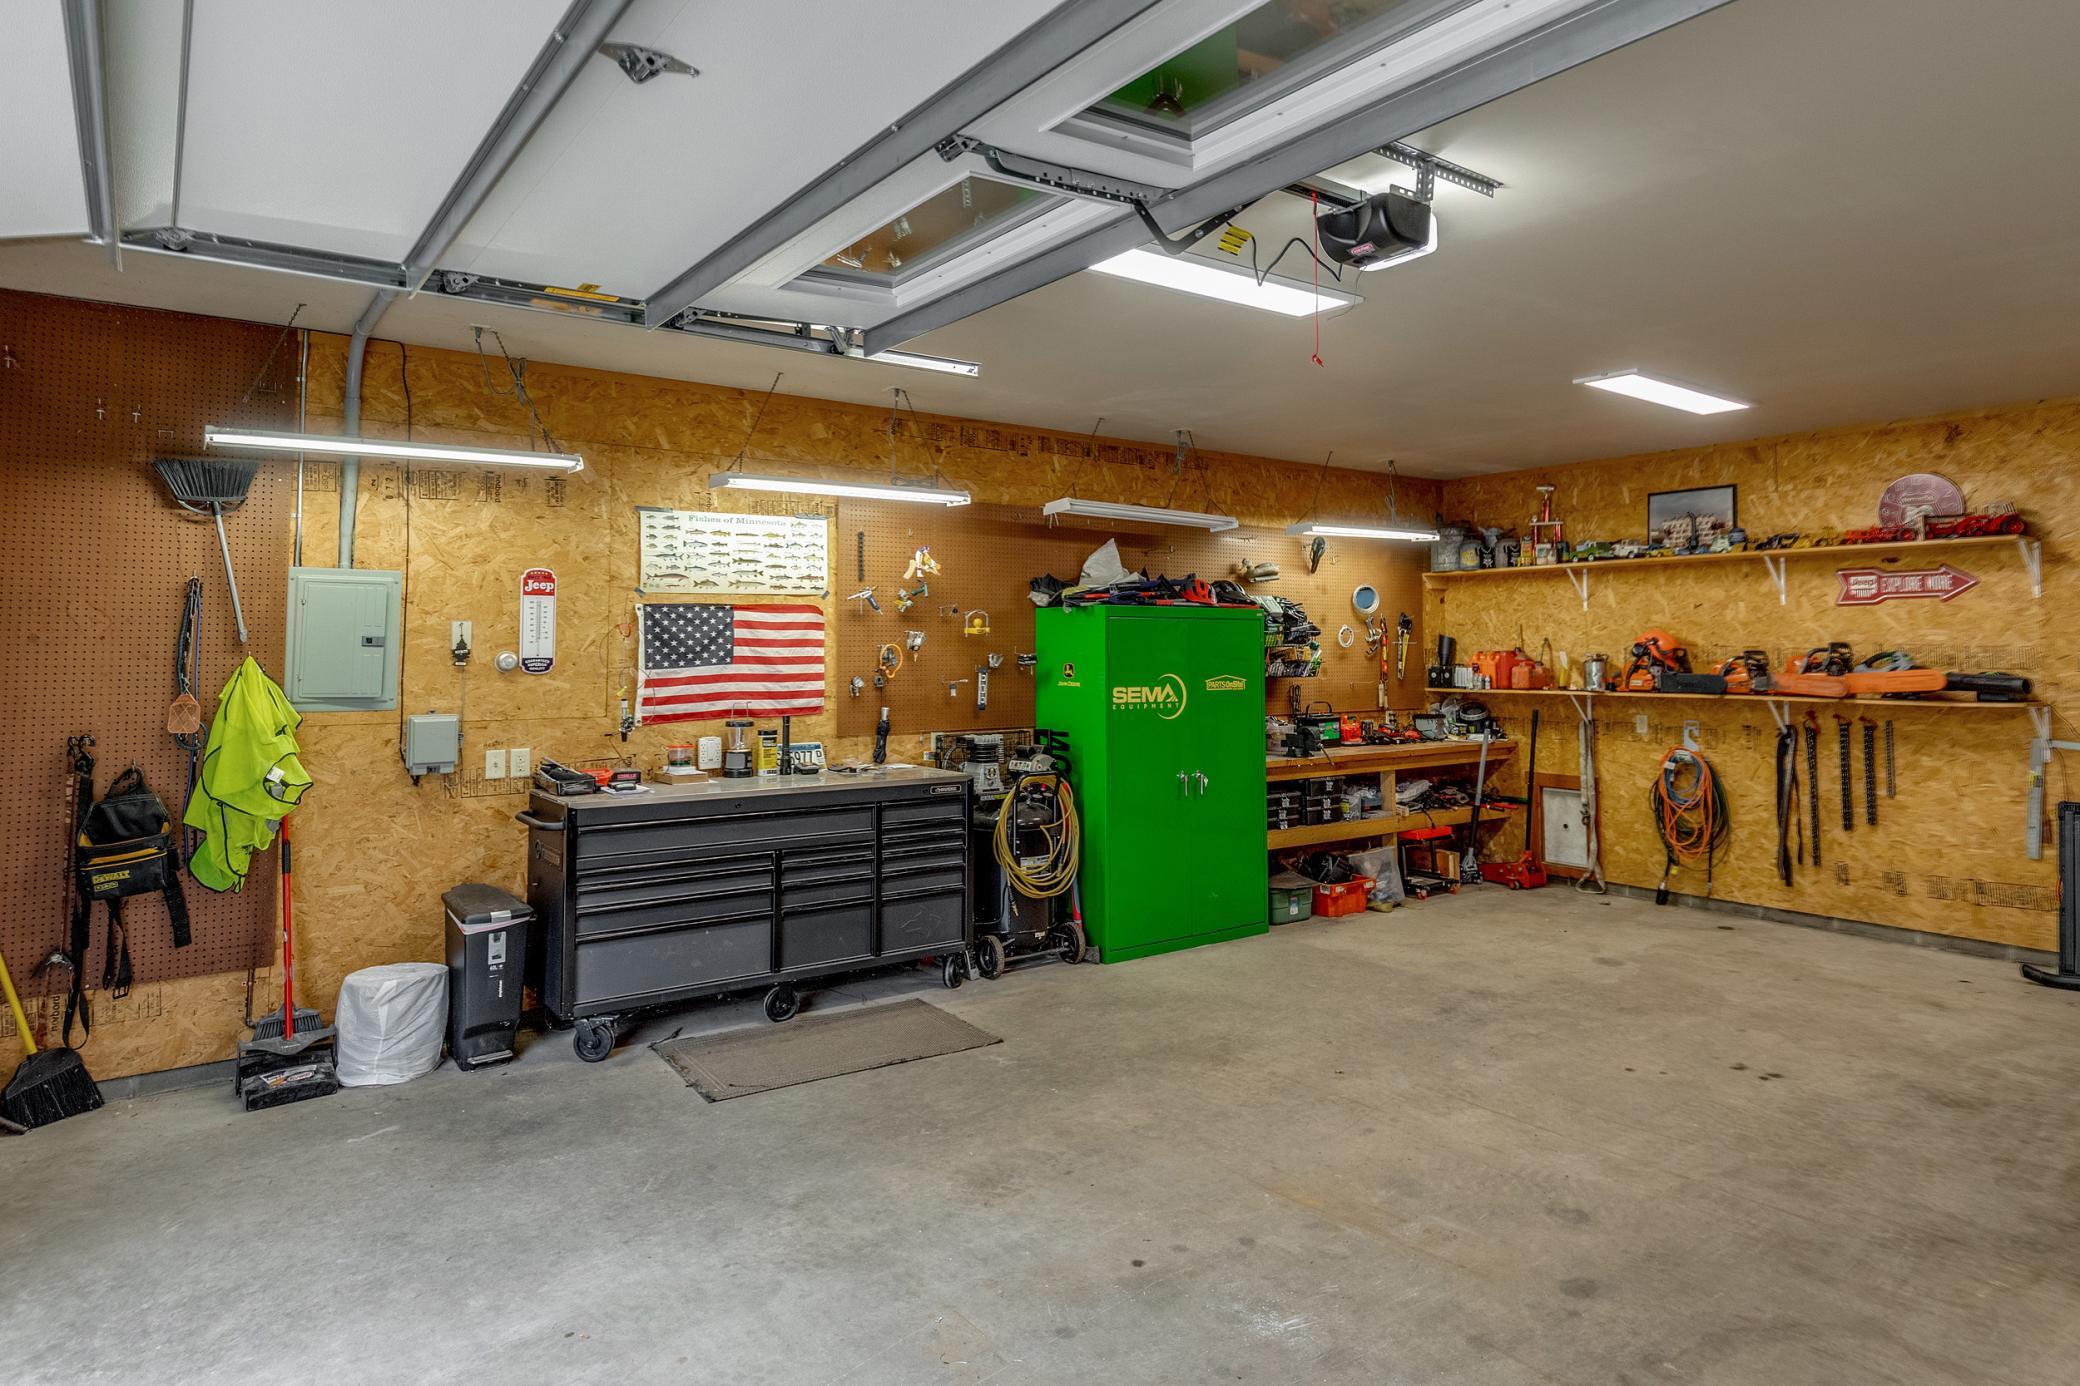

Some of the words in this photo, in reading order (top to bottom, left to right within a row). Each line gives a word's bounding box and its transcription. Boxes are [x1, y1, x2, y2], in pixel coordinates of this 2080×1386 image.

[688, 514, 721, 523] Fishes
[736, 517, 787, 526] Minnesota
[525, 579, 554, 592] Jeep
[1112, 683, 1179, 704] SEMA
